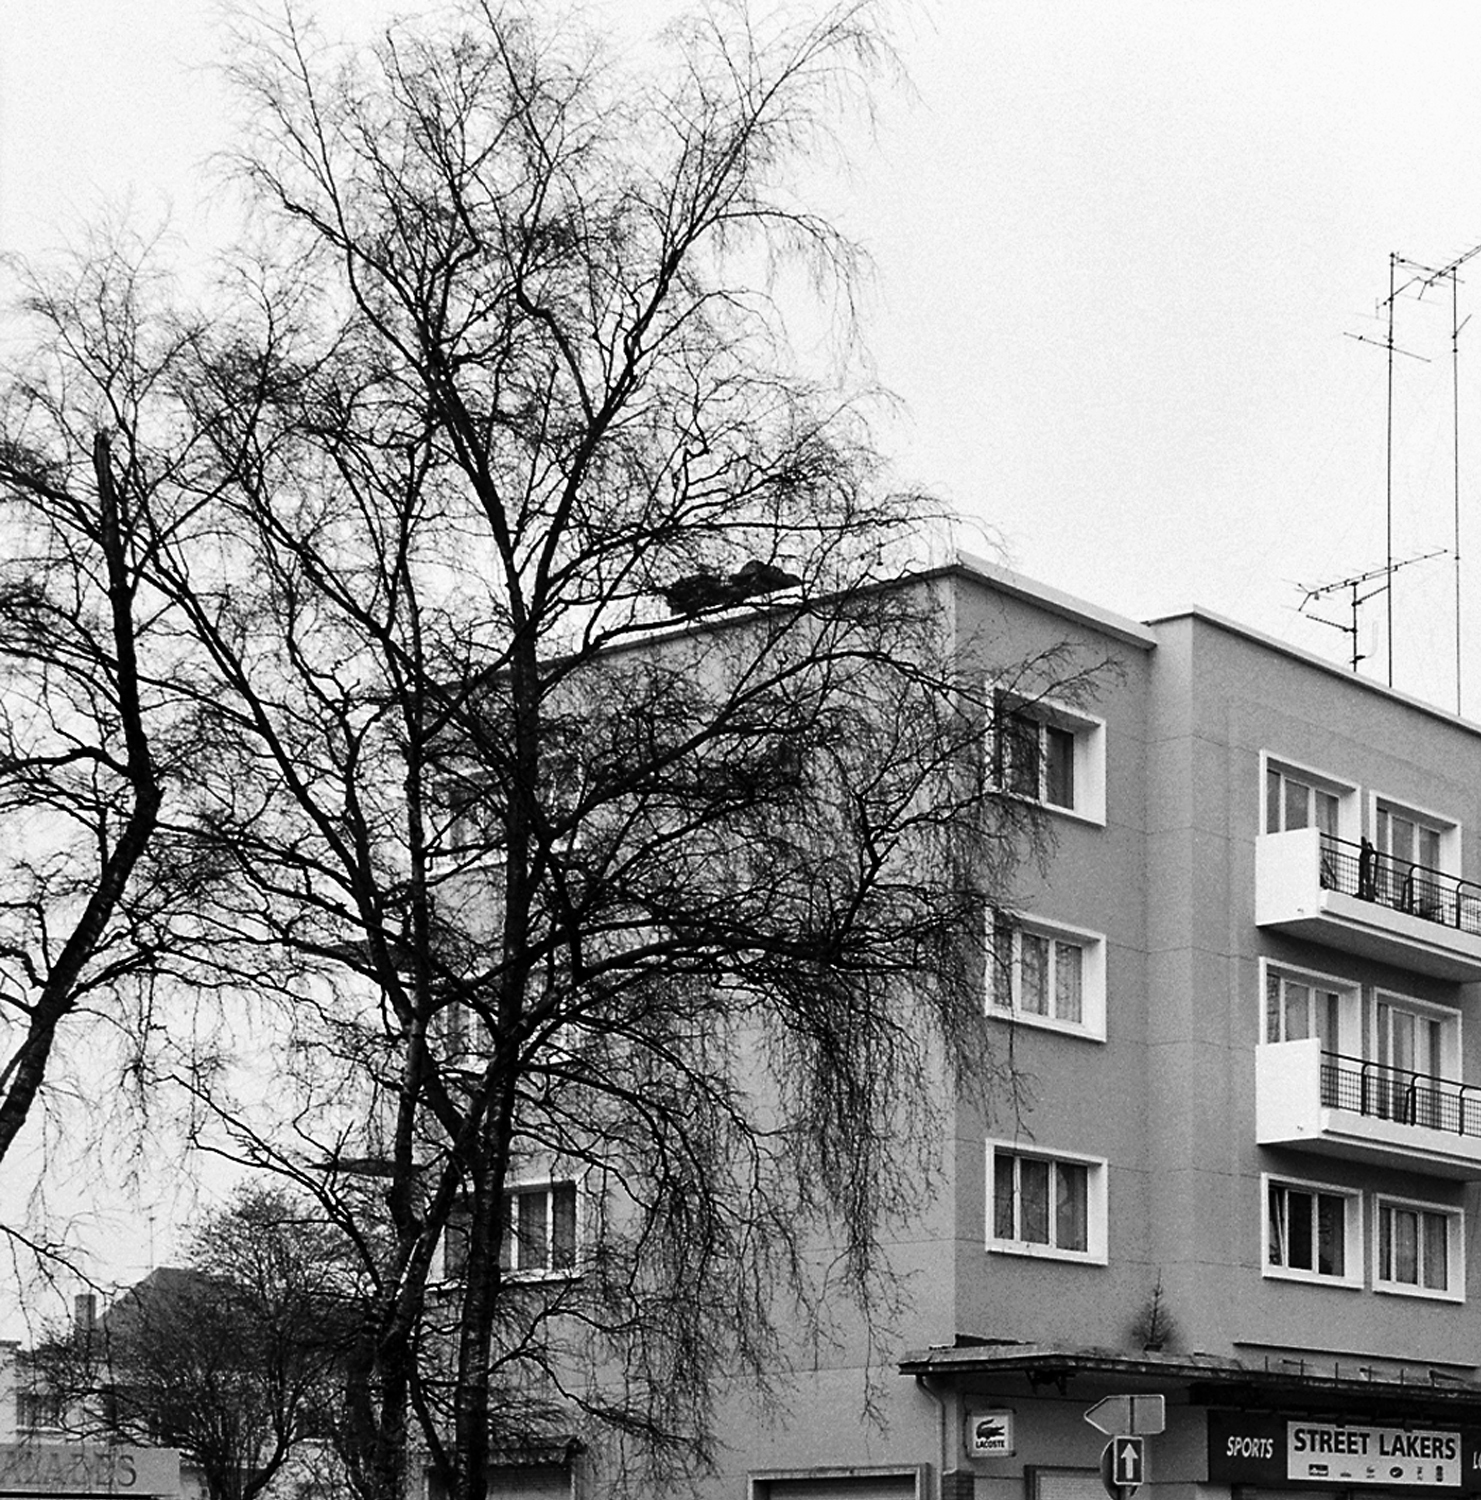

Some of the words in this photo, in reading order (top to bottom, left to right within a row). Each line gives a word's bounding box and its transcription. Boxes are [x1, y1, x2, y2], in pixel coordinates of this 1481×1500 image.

[1226, 1436, 1274, 1459] SPORTS
[1294, 1428, 1370, 1455] STREET
[1379, 1433, 1457, 1460] LAKERS
